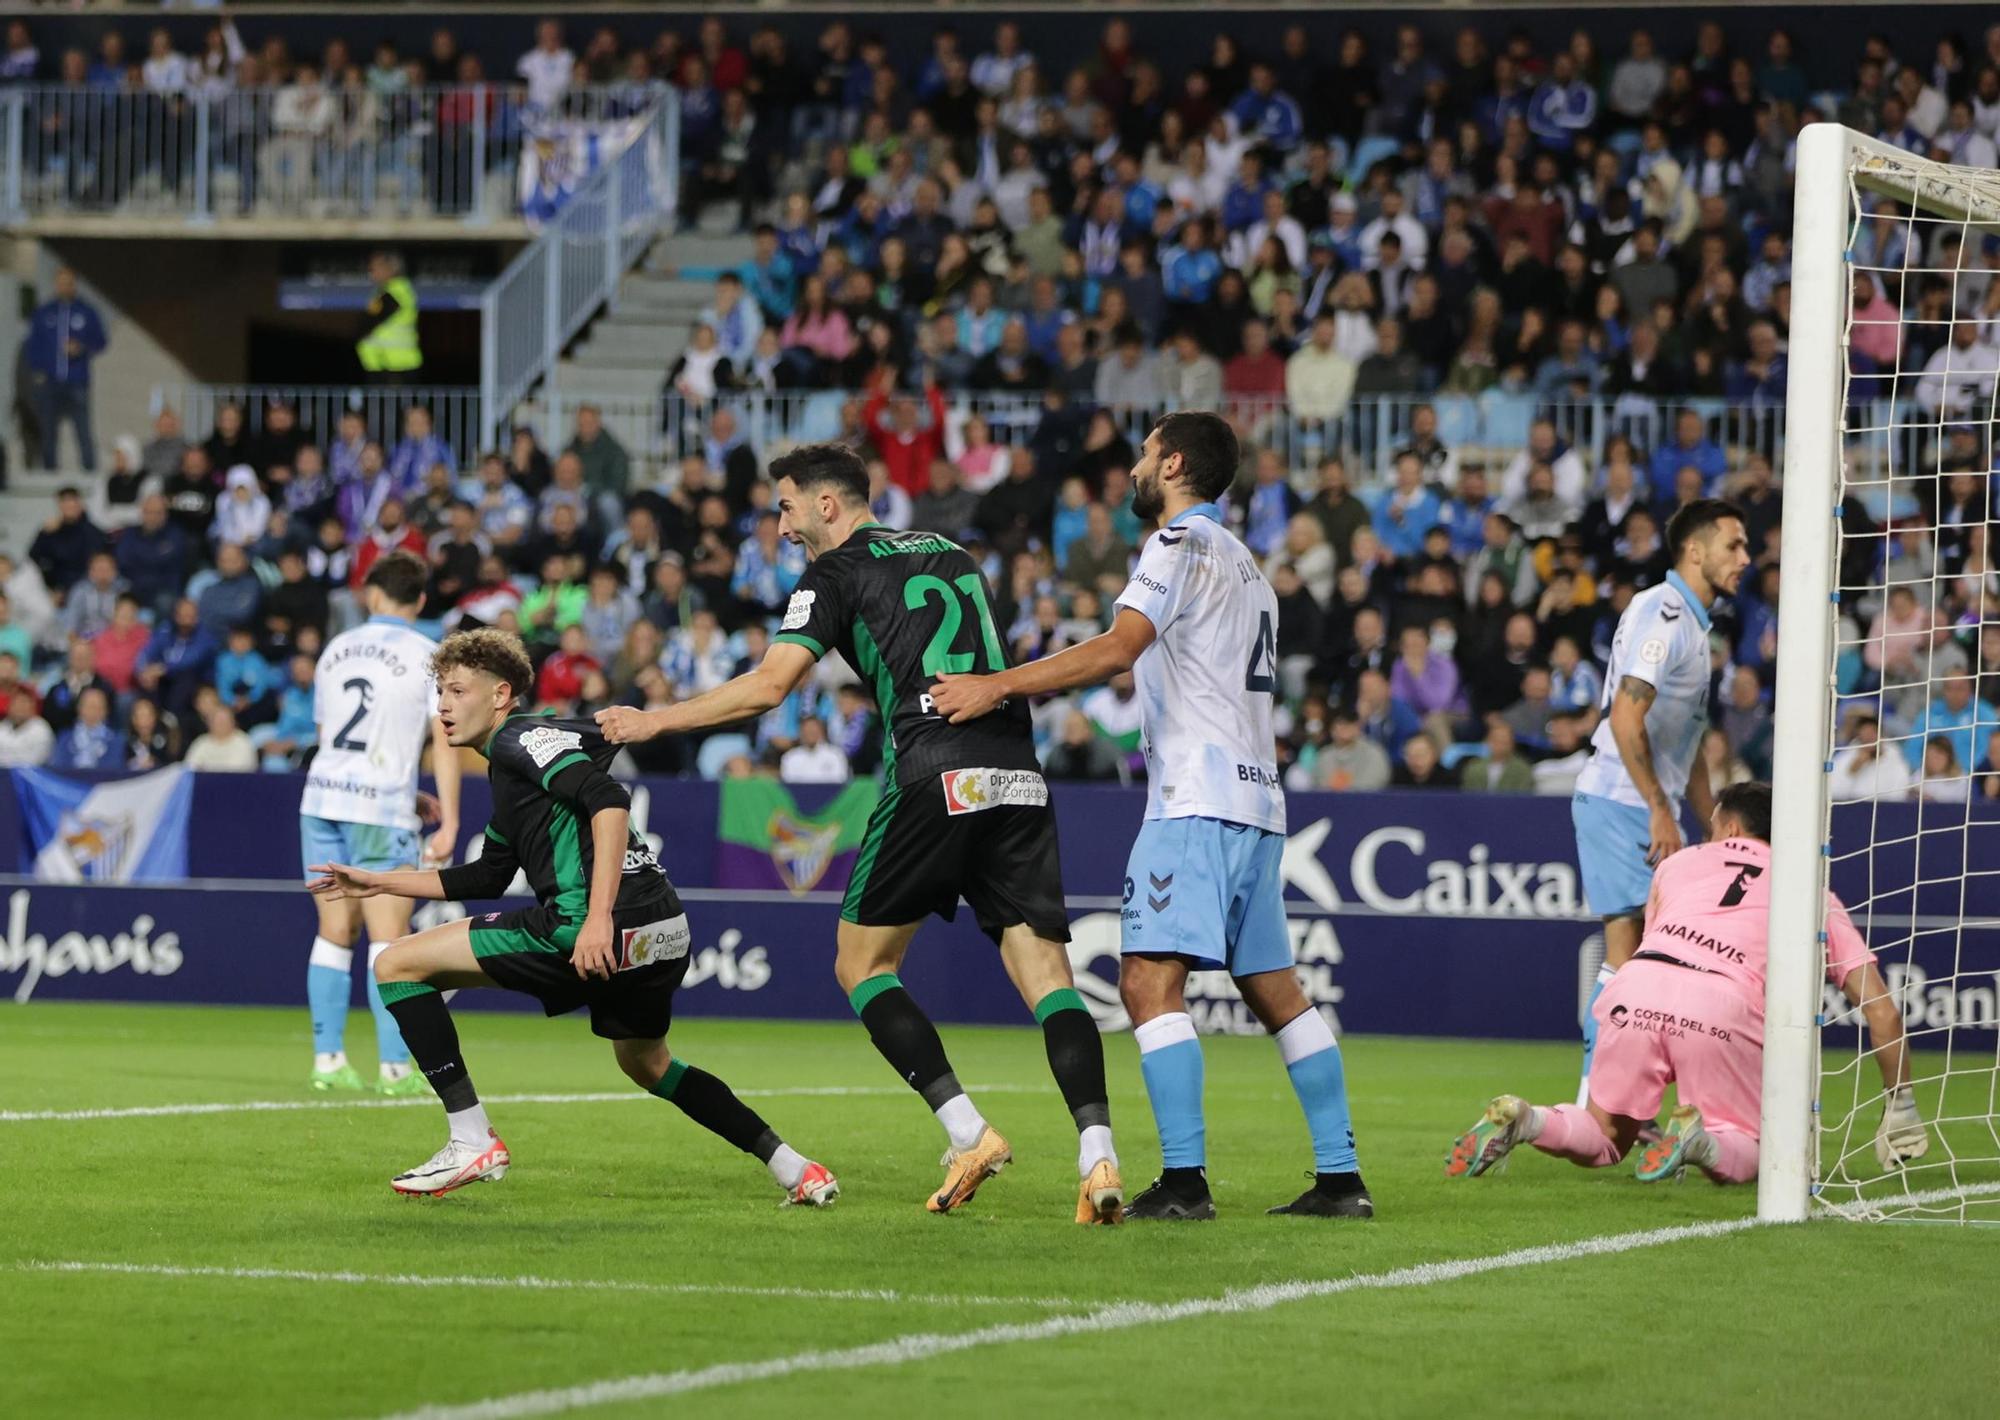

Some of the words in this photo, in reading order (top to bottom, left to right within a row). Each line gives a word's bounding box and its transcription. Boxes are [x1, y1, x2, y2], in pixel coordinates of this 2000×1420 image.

[904, 573, 1006, 677] 21
[1246, 610, 1276, 693] 4
[332, 677, 374, 752] 2
[1237, 764, 1283, 790] BENAH
[1350, 825, 1592, 918] Caixa
[0, 889, 184, 1004] havis
[1656, 922, 1747, 965] NAHAVIS
[1634, 1008, 1676, 1024] COSTA
[1680, 1018, 1705, 1033] DEL
[1709, 1027, 1733, 1042] SOL
